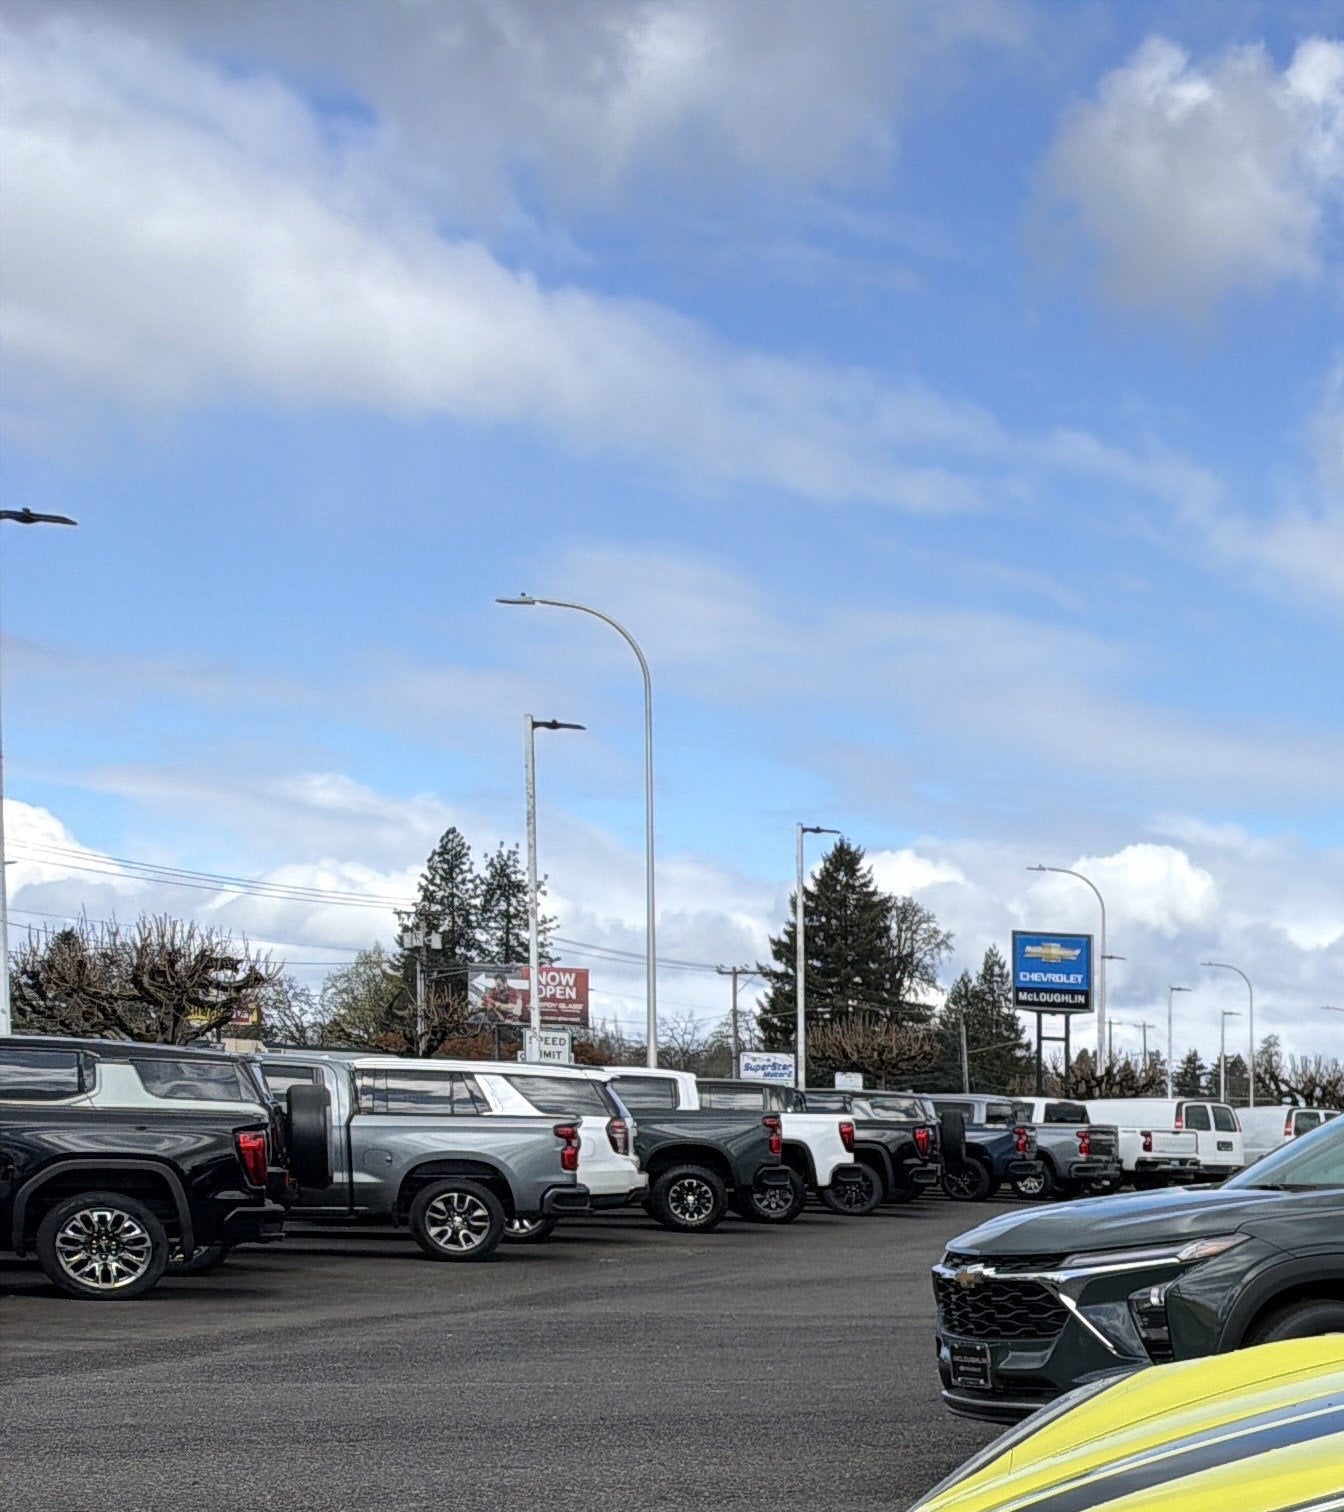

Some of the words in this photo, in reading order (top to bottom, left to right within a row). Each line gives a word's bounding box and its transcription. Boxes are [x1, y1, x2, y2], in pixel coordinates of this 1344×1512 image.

[538, 971, 576, 986] NOW
[1019, 971, 1084, 984] CHEVROLET
[538, 985, 577, 999] OPEN
[1018, 991, 1086, 1004] McLOUGHLIN
[539, 1050, 562, 1060] IMIT
